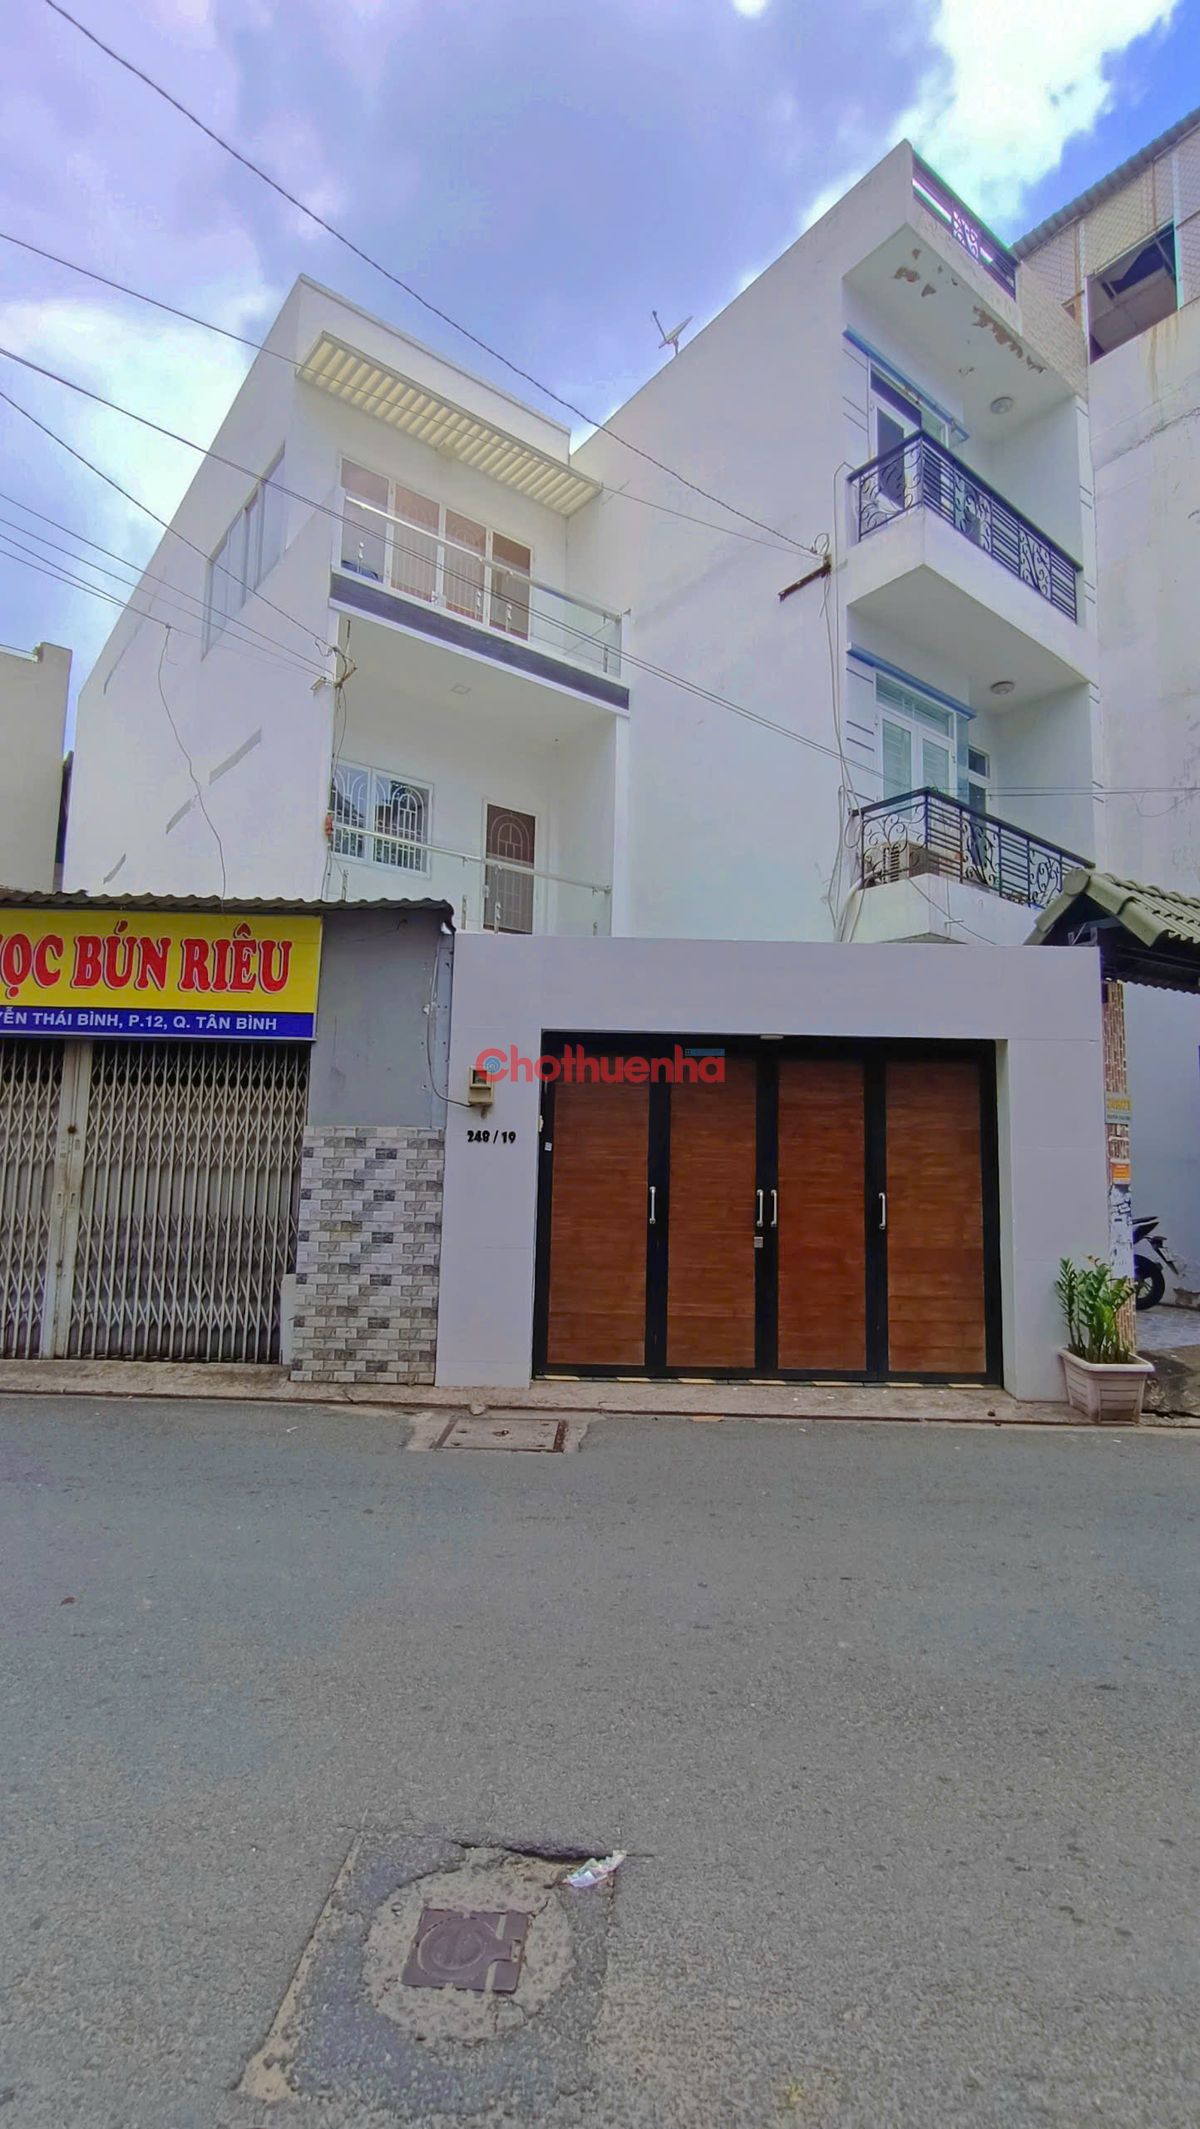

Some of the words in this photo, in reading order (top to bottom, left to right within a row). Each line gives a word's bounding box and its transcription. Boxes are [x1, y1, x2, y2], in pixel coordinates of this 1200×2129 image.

[0, 931, 64, 999] ỌC
[71, 919, 172, 991] BÚN
[179, 922, 294, 994] RIÊU
[32, 1010, 73, 1026] THÁI
[77, 1011, 123, 1029] BÌNH,
[128, 1015, 168, 1030] P.12,
[173, 1015, 190, 1028] Q.
[196, 1014, 231, 1029] TÂN
[236, 1015, 277, 1030] BÌNH
